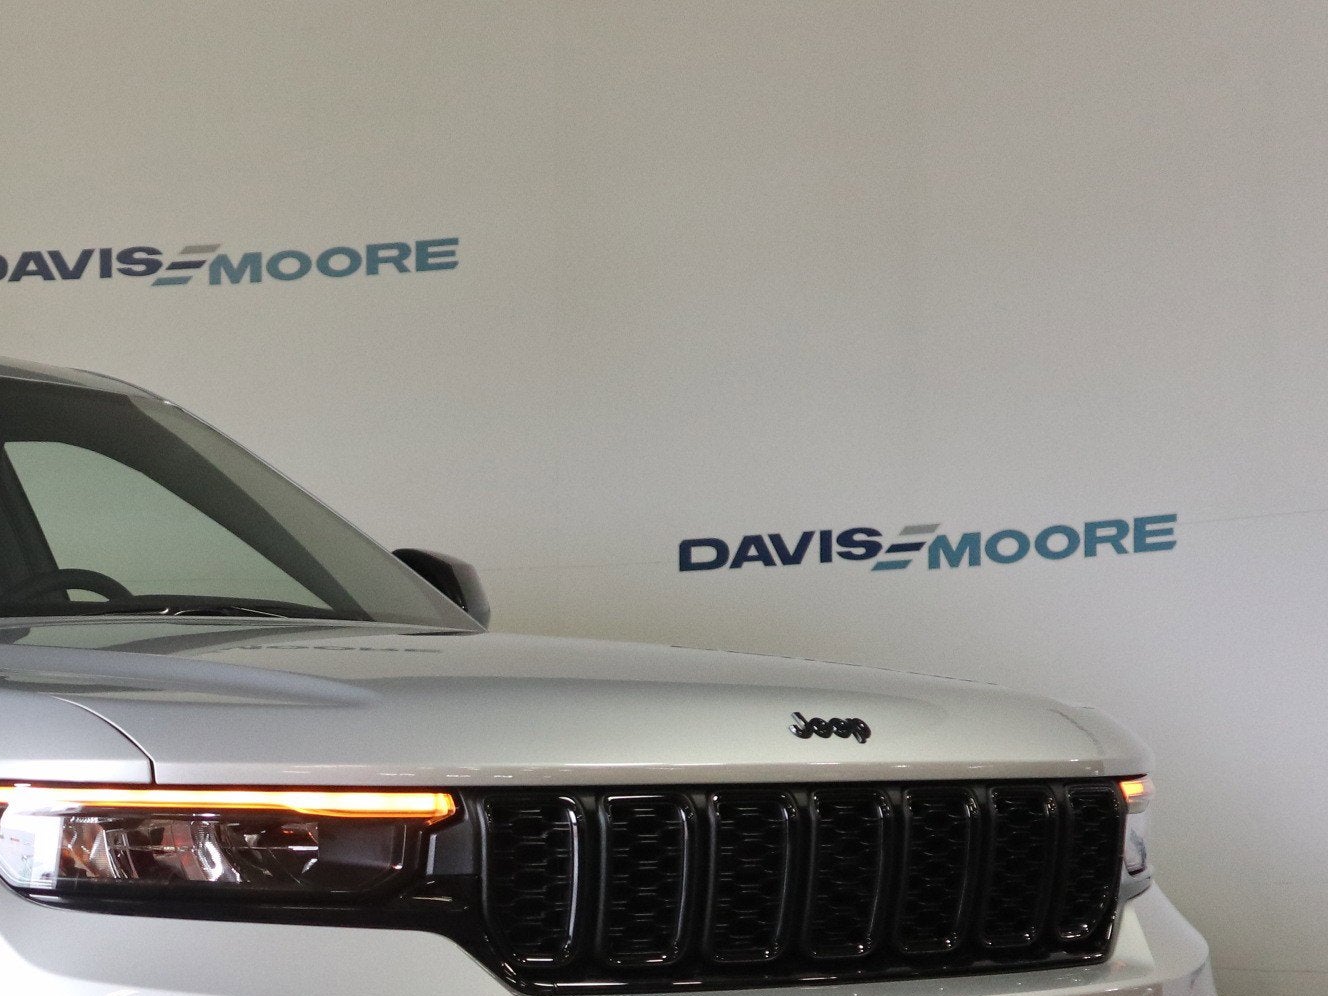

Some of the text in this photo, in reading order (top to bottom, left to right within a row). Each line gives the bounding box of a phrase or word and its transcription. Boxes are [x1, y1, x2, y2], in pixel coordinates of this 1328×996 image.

[209, 236, 460, 286] MOORE
[678, 513, 1178, 573] DAVIS MOORE
[788, 711, 872, 744] Jeep
